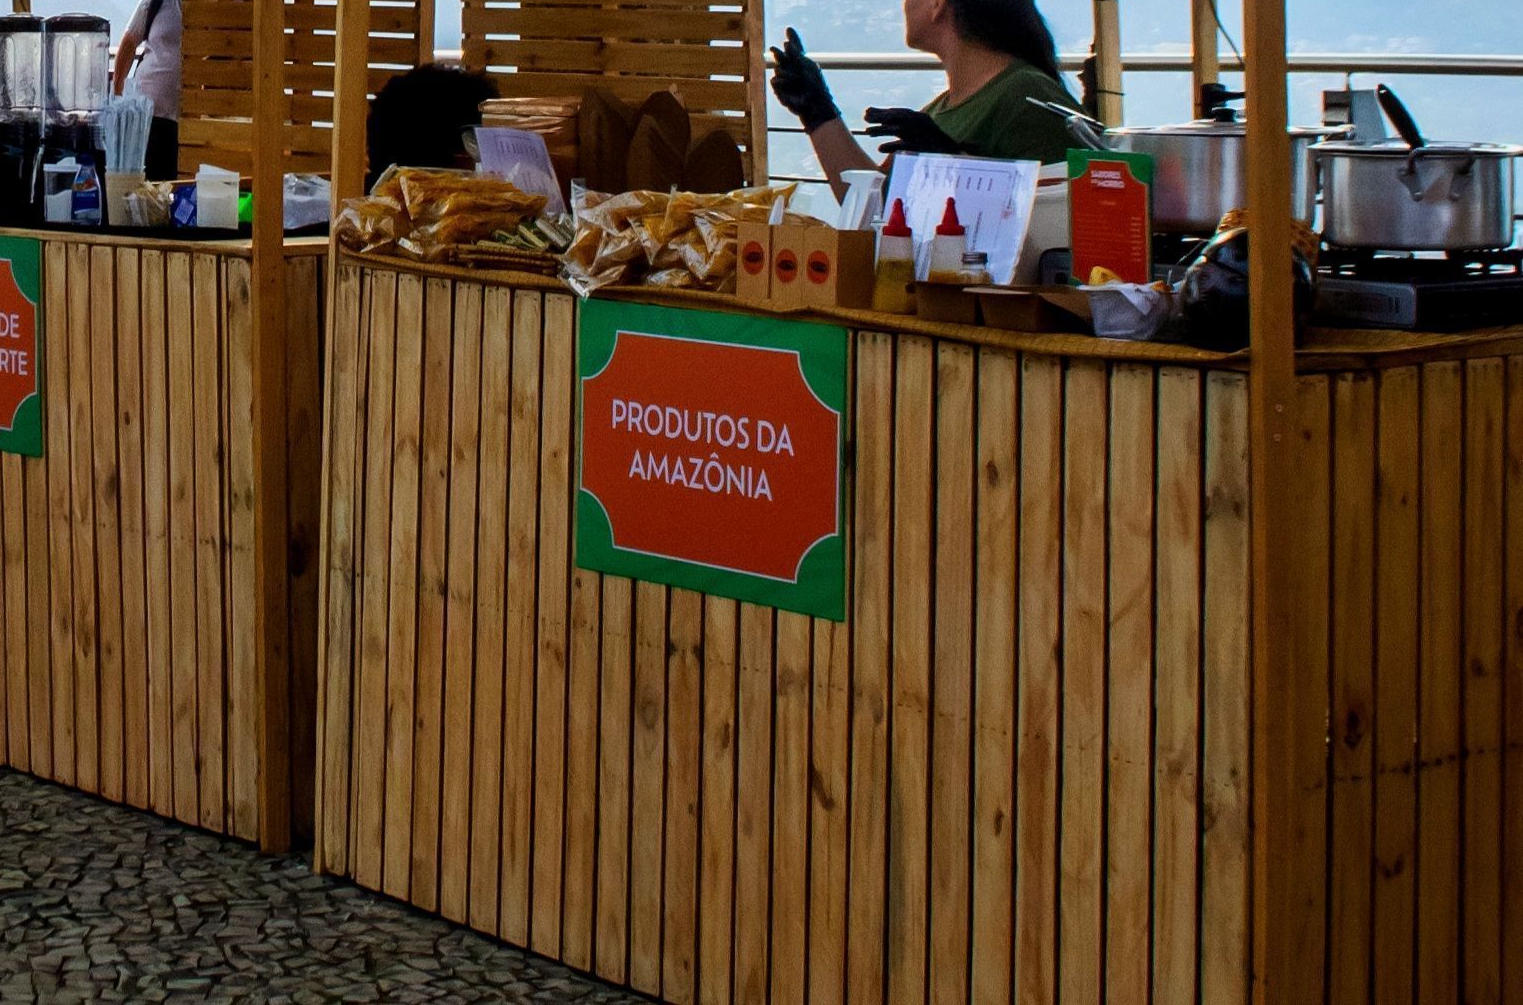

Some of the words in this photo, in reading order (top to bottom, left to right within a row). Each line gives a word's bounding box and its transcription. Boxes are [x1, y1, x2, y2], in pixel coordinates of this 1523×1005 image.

[611, 399, 750, 450] PRODUTOS
[756, 420, 795, 457] DA
[628, 448, 773, 501] AMAZÔNIA
